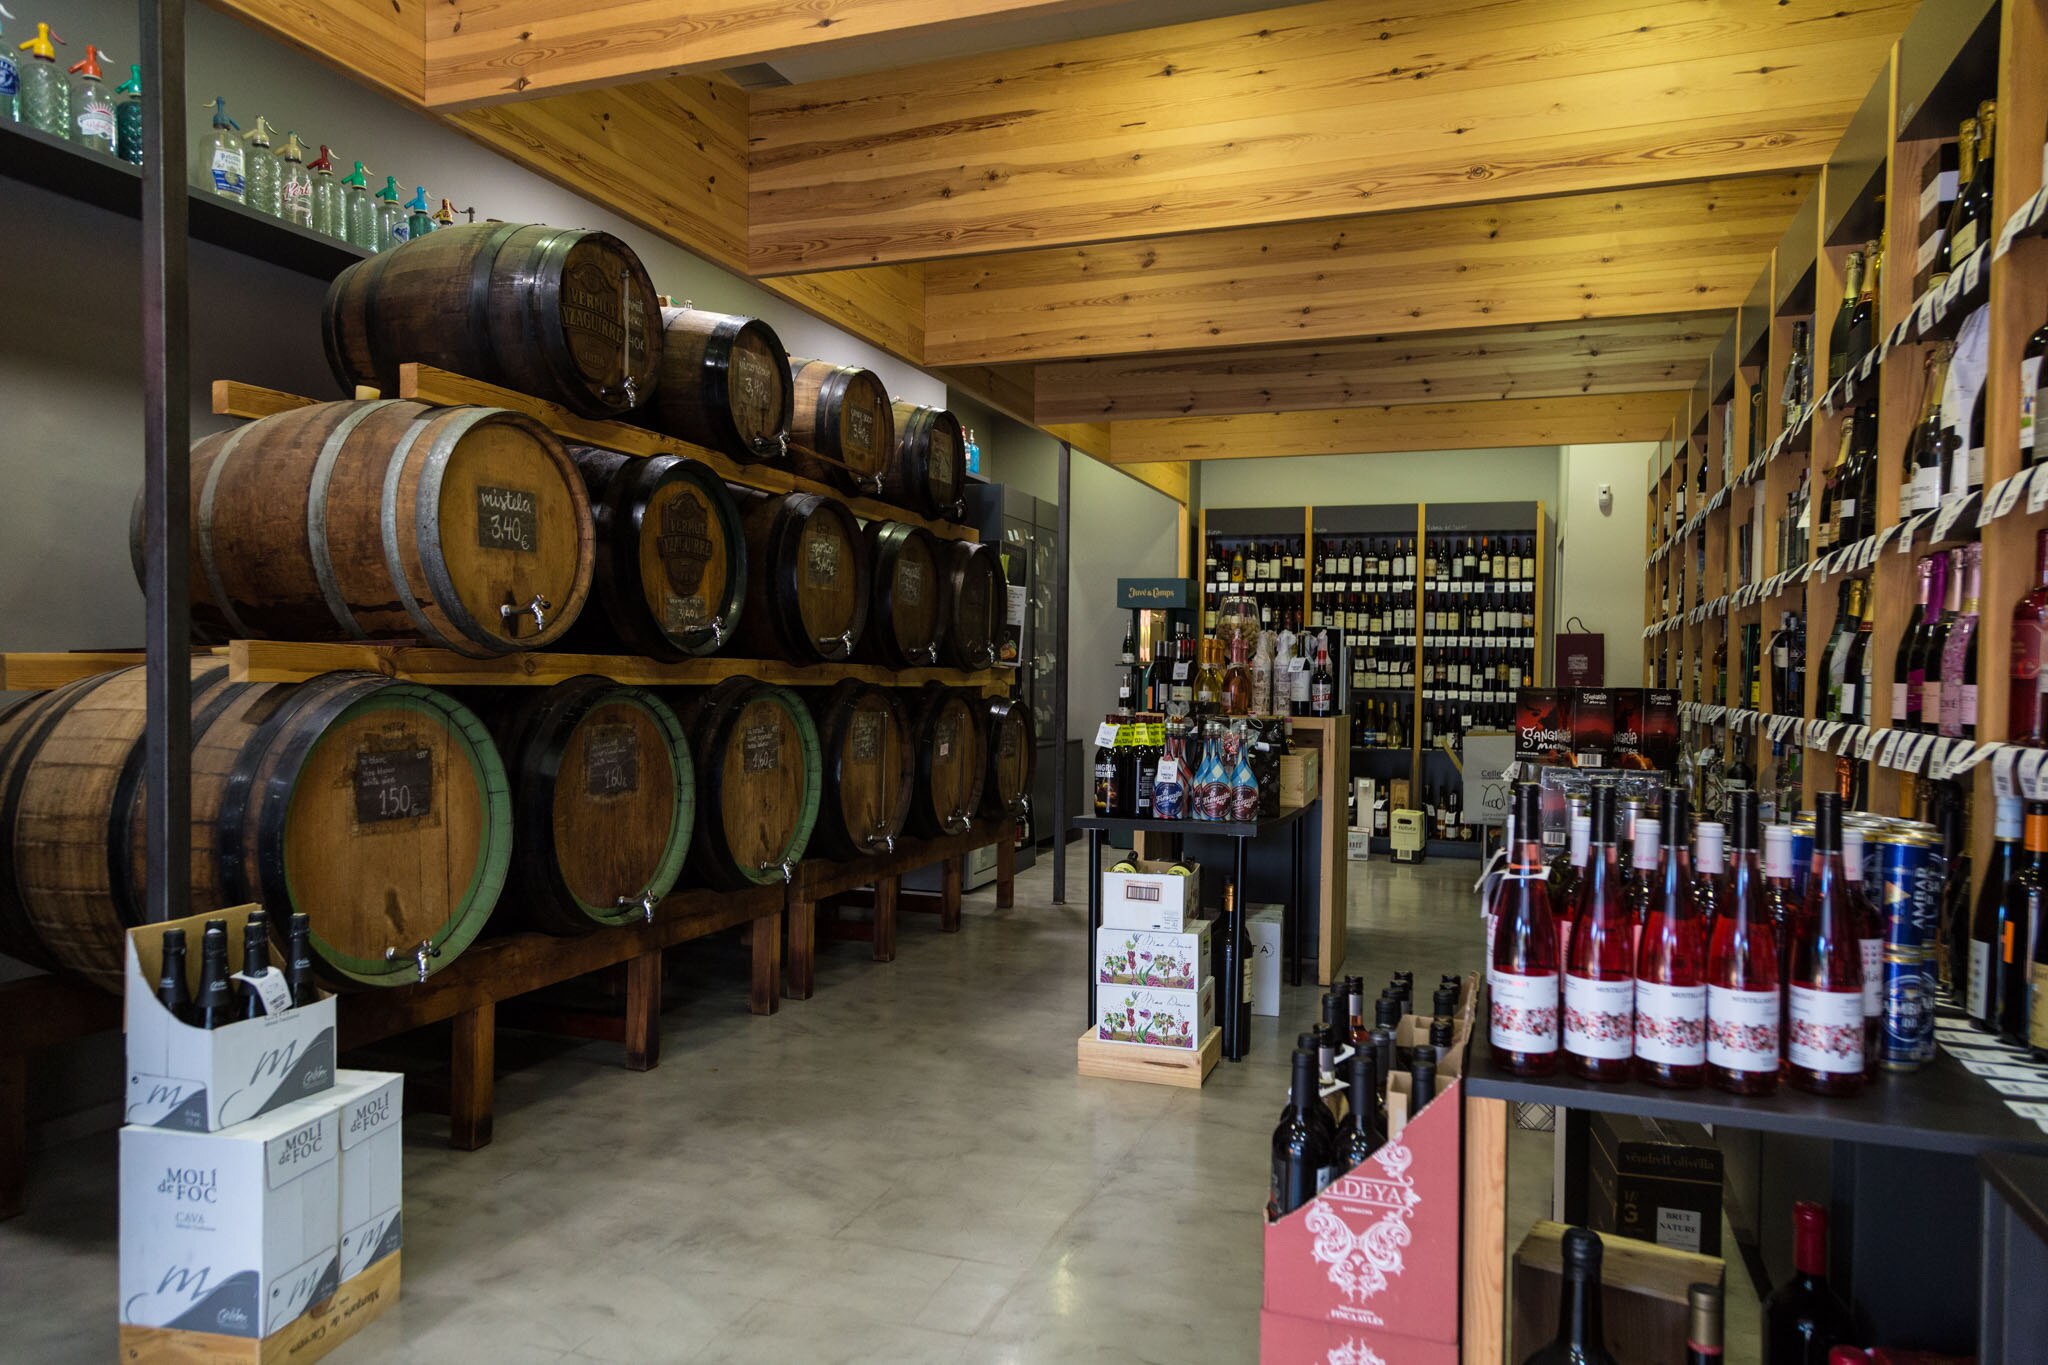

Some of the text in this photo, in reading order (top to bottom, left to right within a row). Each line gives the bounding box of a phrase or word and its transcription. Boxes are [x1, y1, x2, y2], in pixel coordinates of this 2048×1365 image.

[482, 489, 531, 513] mistela
[1912, 868, 1928, 929] AMBAR
[351, 1108, 389, 1132] de FOC
[278, 1137, 323, 1166] de FOC
[167, 1167, 217, 1187] MOLÍ
[158, 1178, 217, 1203] de FOC
[176, 1212, 205, 1224] CAVA
[1660, 1223, 1697, 1233] NATURE
[1666, 1212, 1692, 1221] BRUT
